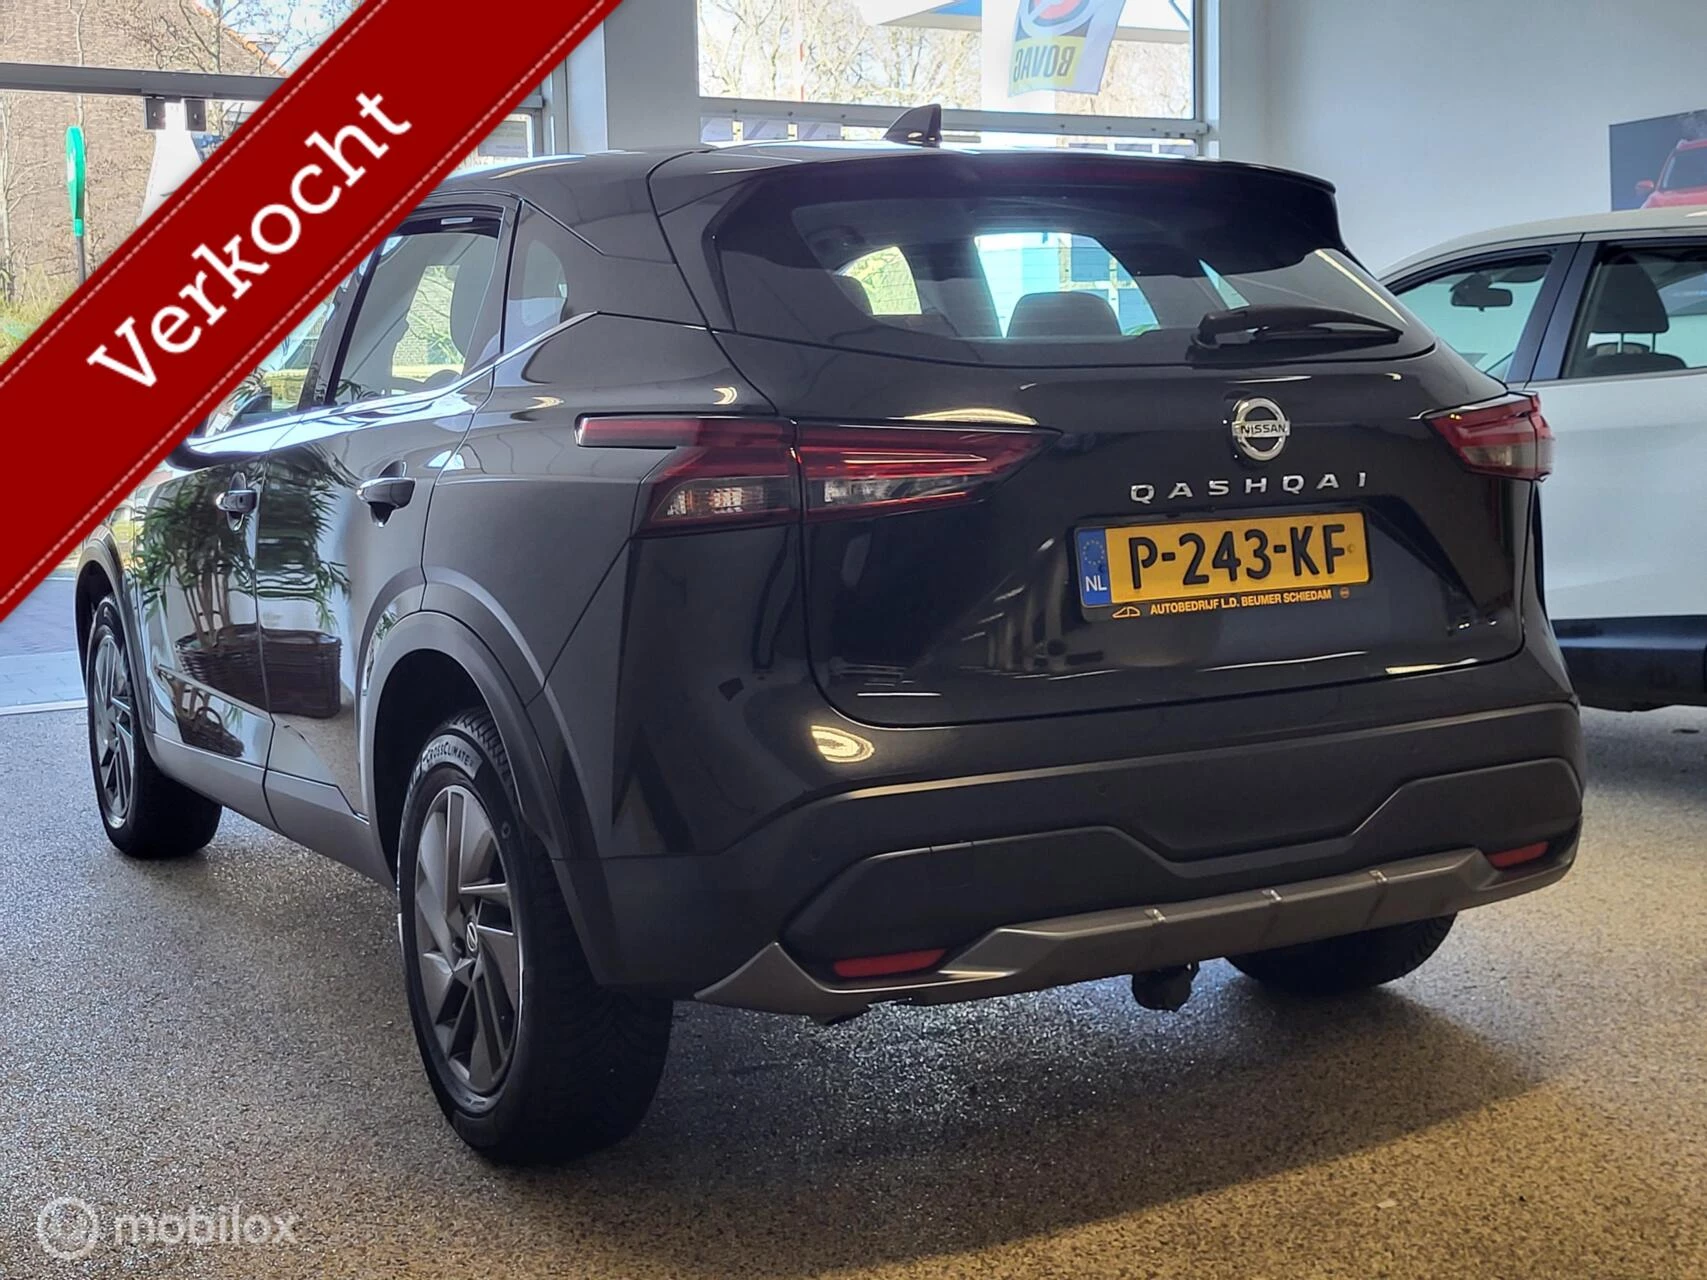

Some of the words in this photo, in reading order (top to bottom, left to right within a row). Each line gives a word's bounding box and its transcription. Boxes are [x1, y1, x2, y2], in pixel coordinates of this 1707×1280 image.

[1240, 424, 1286, 434] NISSAN
[1130, 472, 1367, 504] QASHQAI
[1128, 523, 1346, 590] P-243-KF
[1085, 575, 1107, 593] NL
[1150, 599, 1219, 615] AUTOBEDRIJF
[1221, 597, 1240, 609] L.D.
[1241, 593, 1282, 606] BEUMER
[1283, 589, 1332, 604] SCHIEDAM
